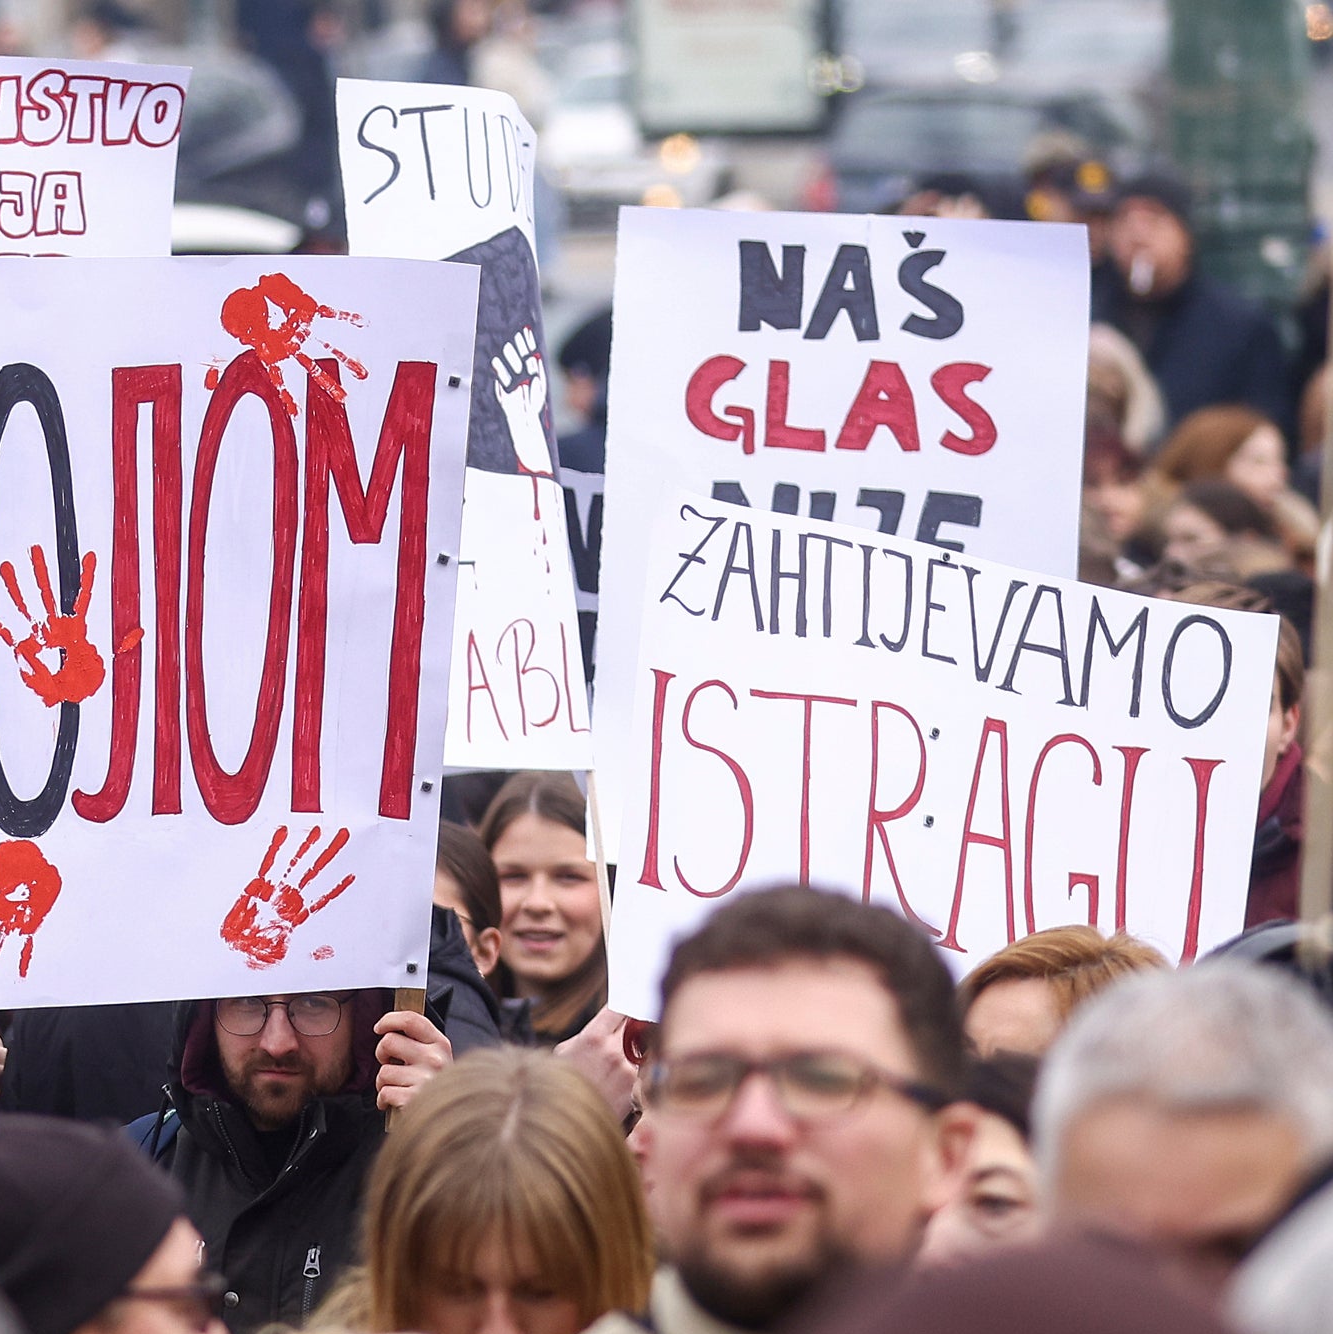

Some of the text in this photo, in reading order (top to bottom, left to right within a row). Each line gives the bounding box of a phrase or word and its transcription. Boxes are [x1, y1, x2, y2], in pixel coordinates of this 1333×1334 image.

[738, 231, 965, 342] NAŠ
[685, 354, 998, 456] GLAS
[659, 504, 1233, 729] ZAHTIJEVAMO
[637, 667, 1227, 968] ISTRAGU
